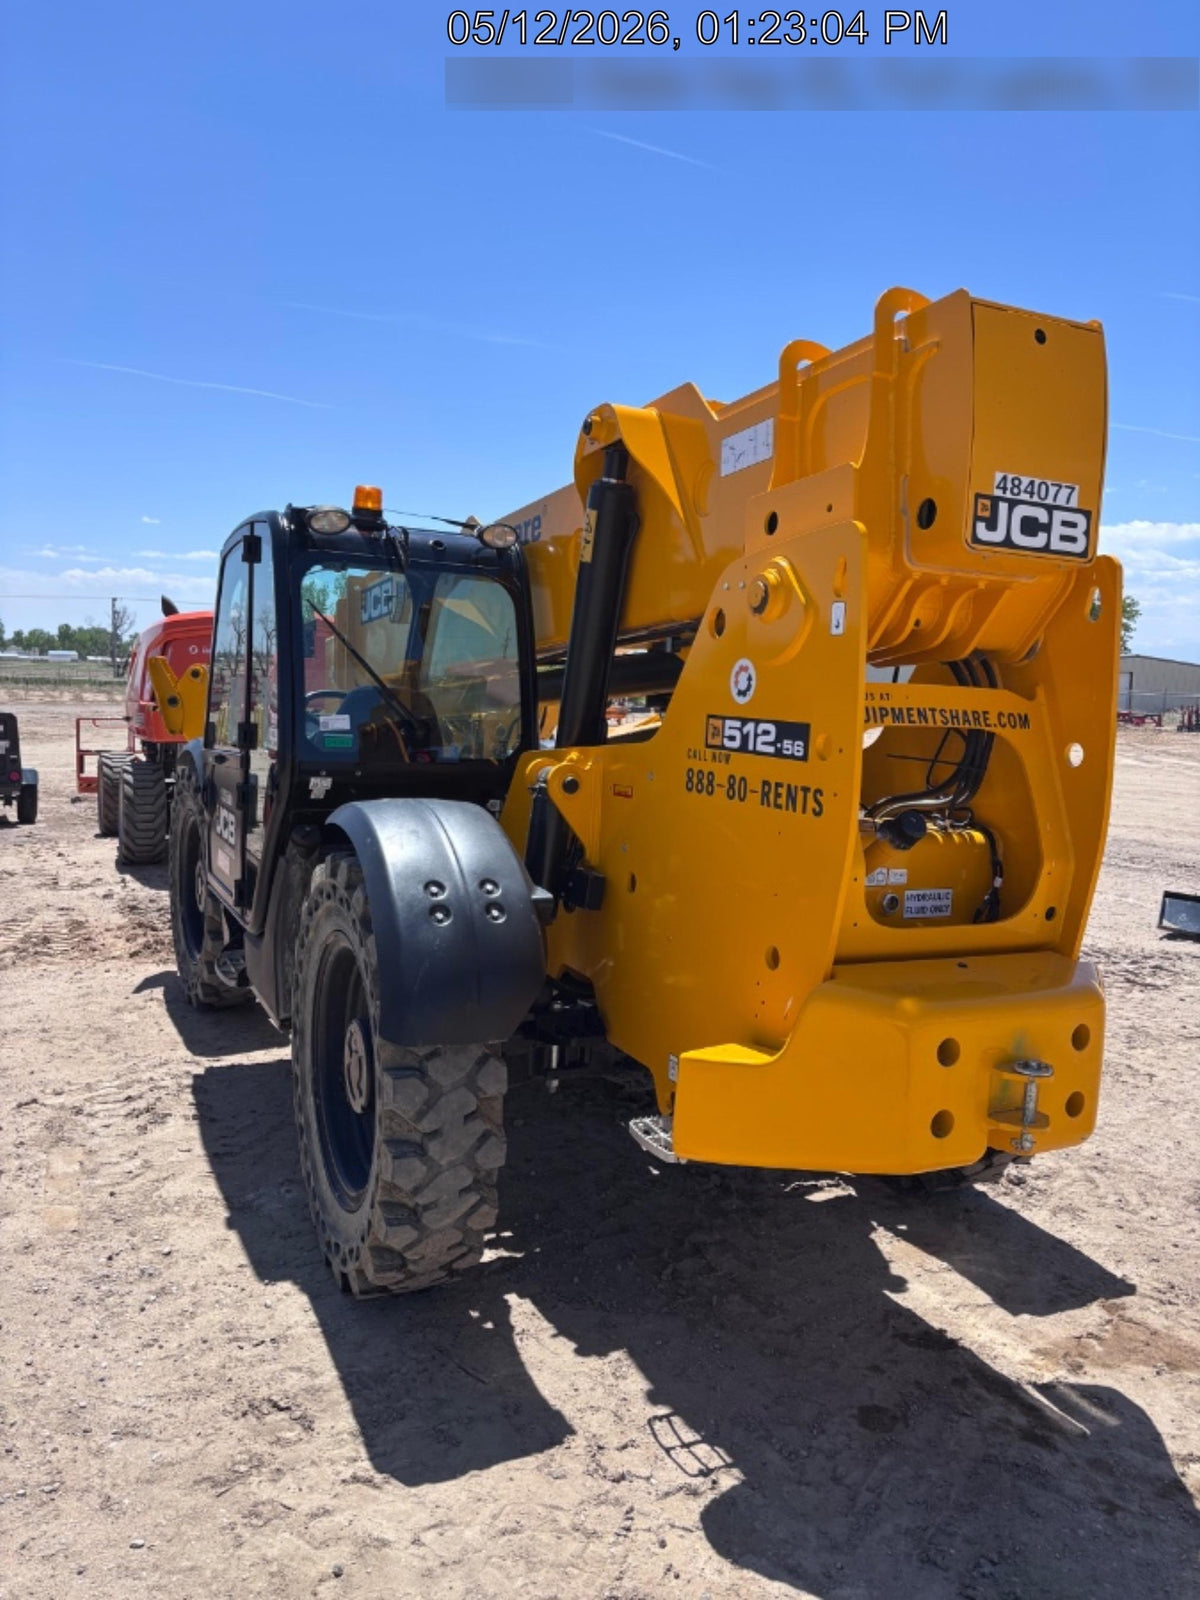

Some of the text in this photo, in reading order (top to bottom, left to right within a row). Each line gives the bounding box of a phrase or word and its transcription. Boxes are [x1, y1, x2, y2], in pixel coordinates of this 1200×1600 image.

[995, 474, 1075, 505] 484077
[975, 500, 1087, 554] JCB
[687, 748, 731, 765] CALL NOW
[685, 767, 824, 817] 888-80-RENTS
